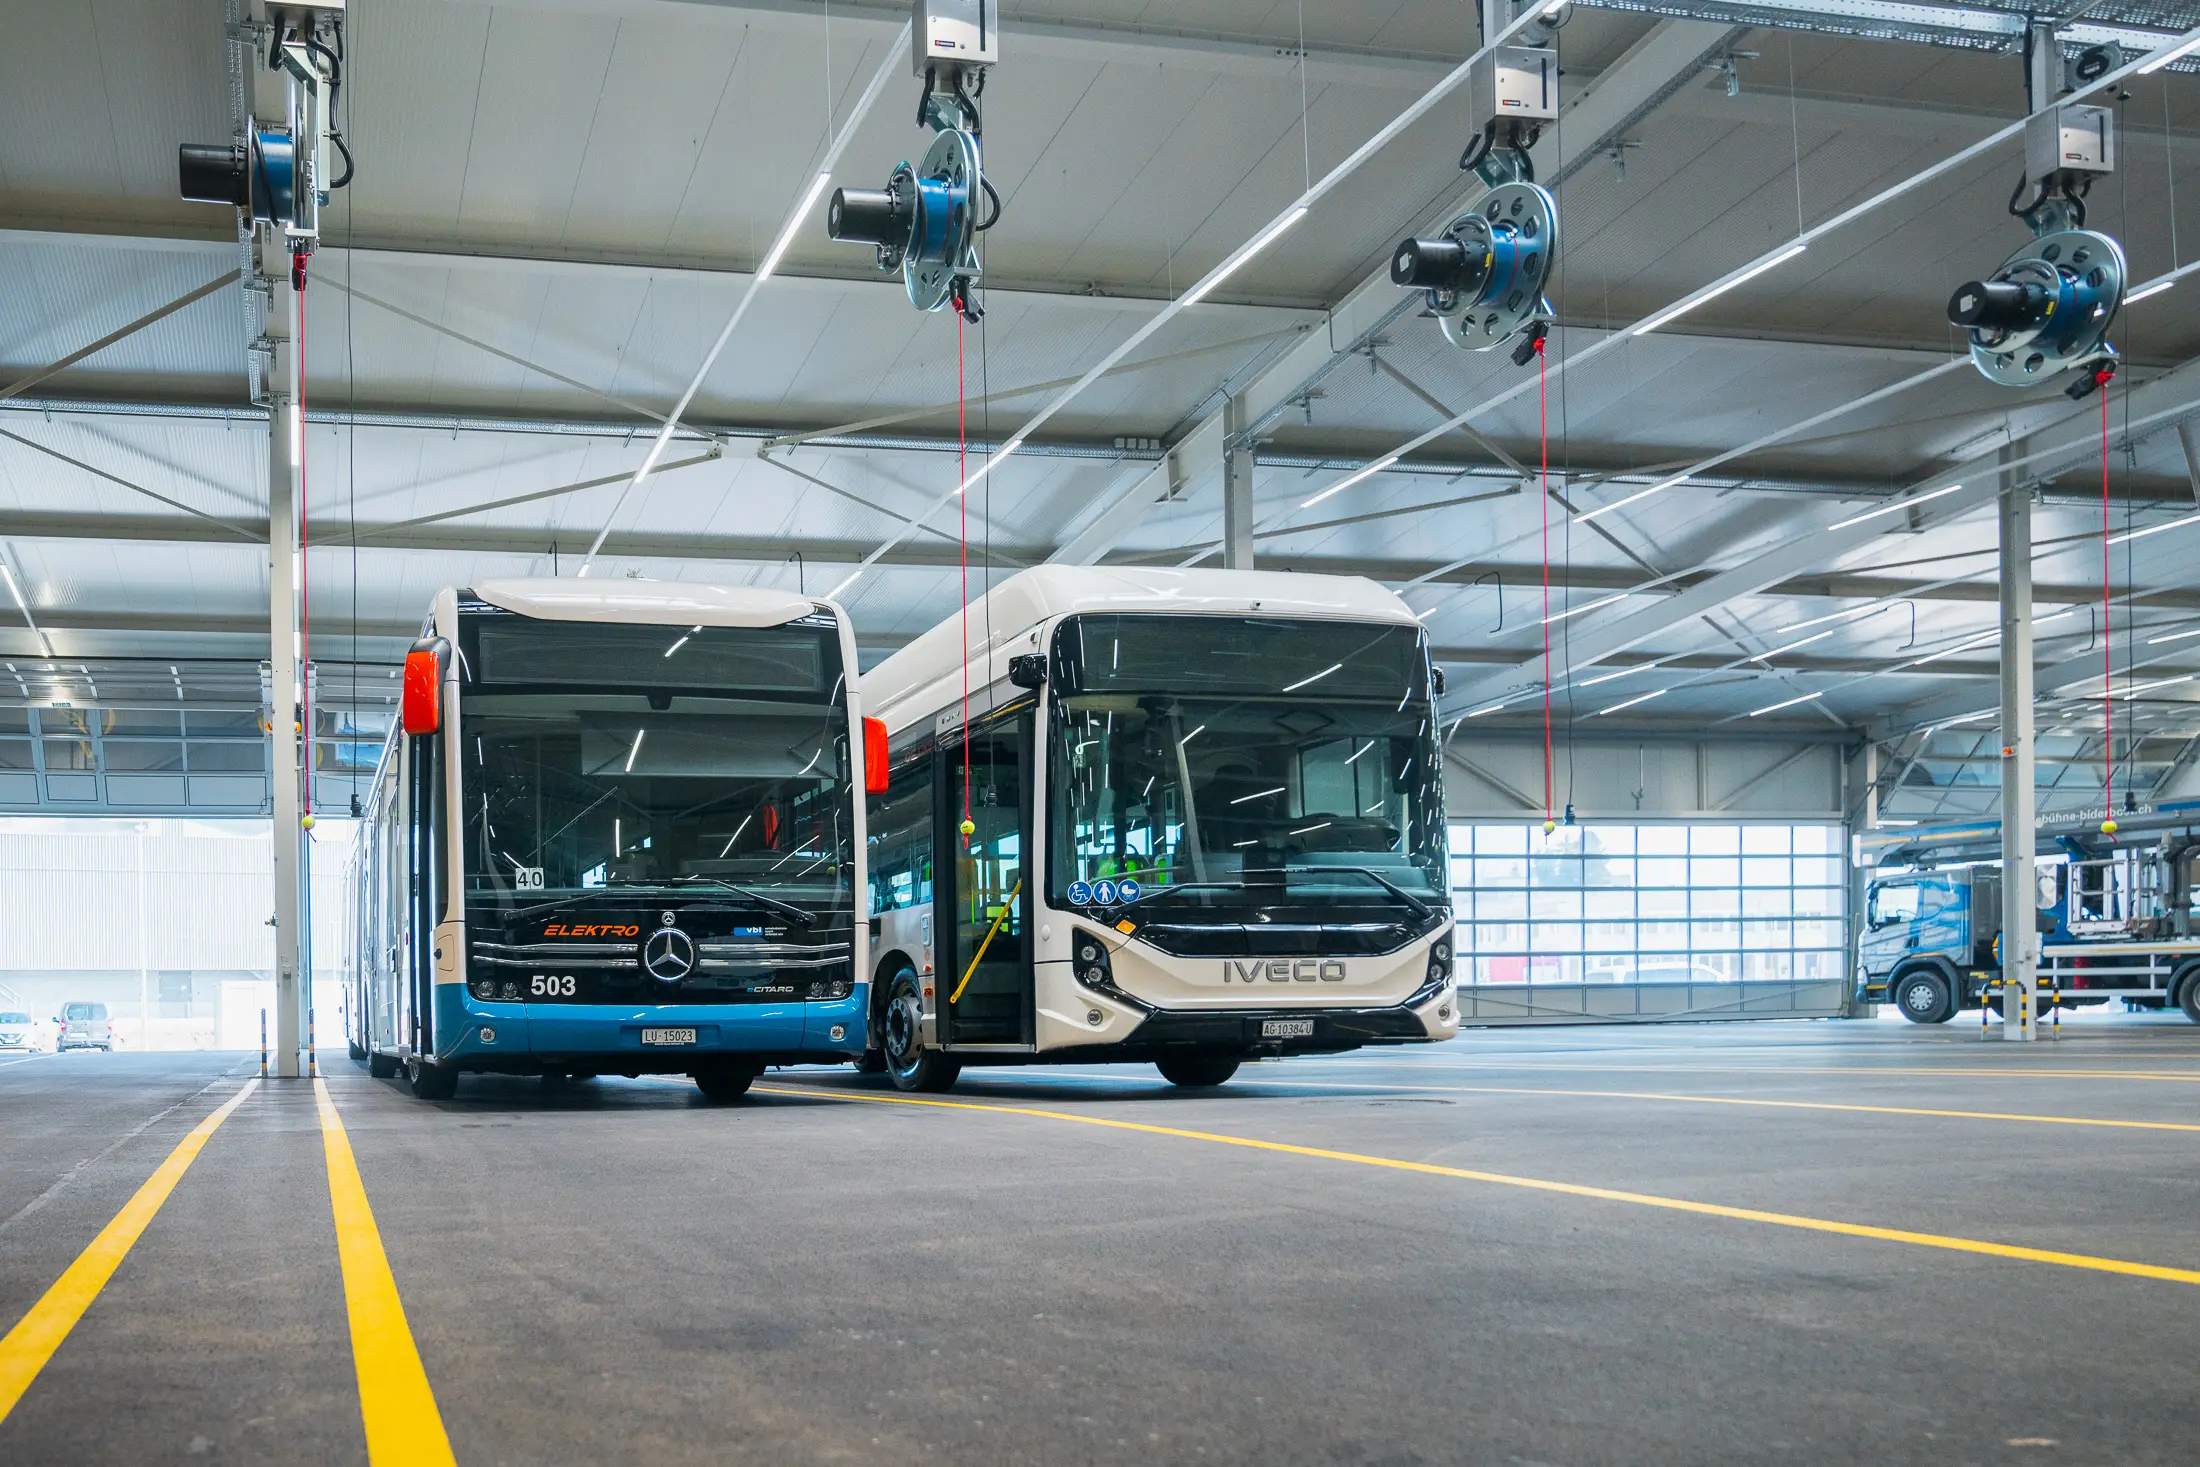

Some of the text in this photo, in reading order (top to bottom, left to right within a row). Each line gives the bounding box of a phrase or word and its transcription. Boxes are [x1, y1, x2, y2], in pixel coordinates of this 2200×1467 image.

[517, 871, 543, 887] 40
[544, 924, 639, 937] ELEKTRO
[1224, 960, 1346, 983] IVECO
[530, 975, 576, 996] 503
